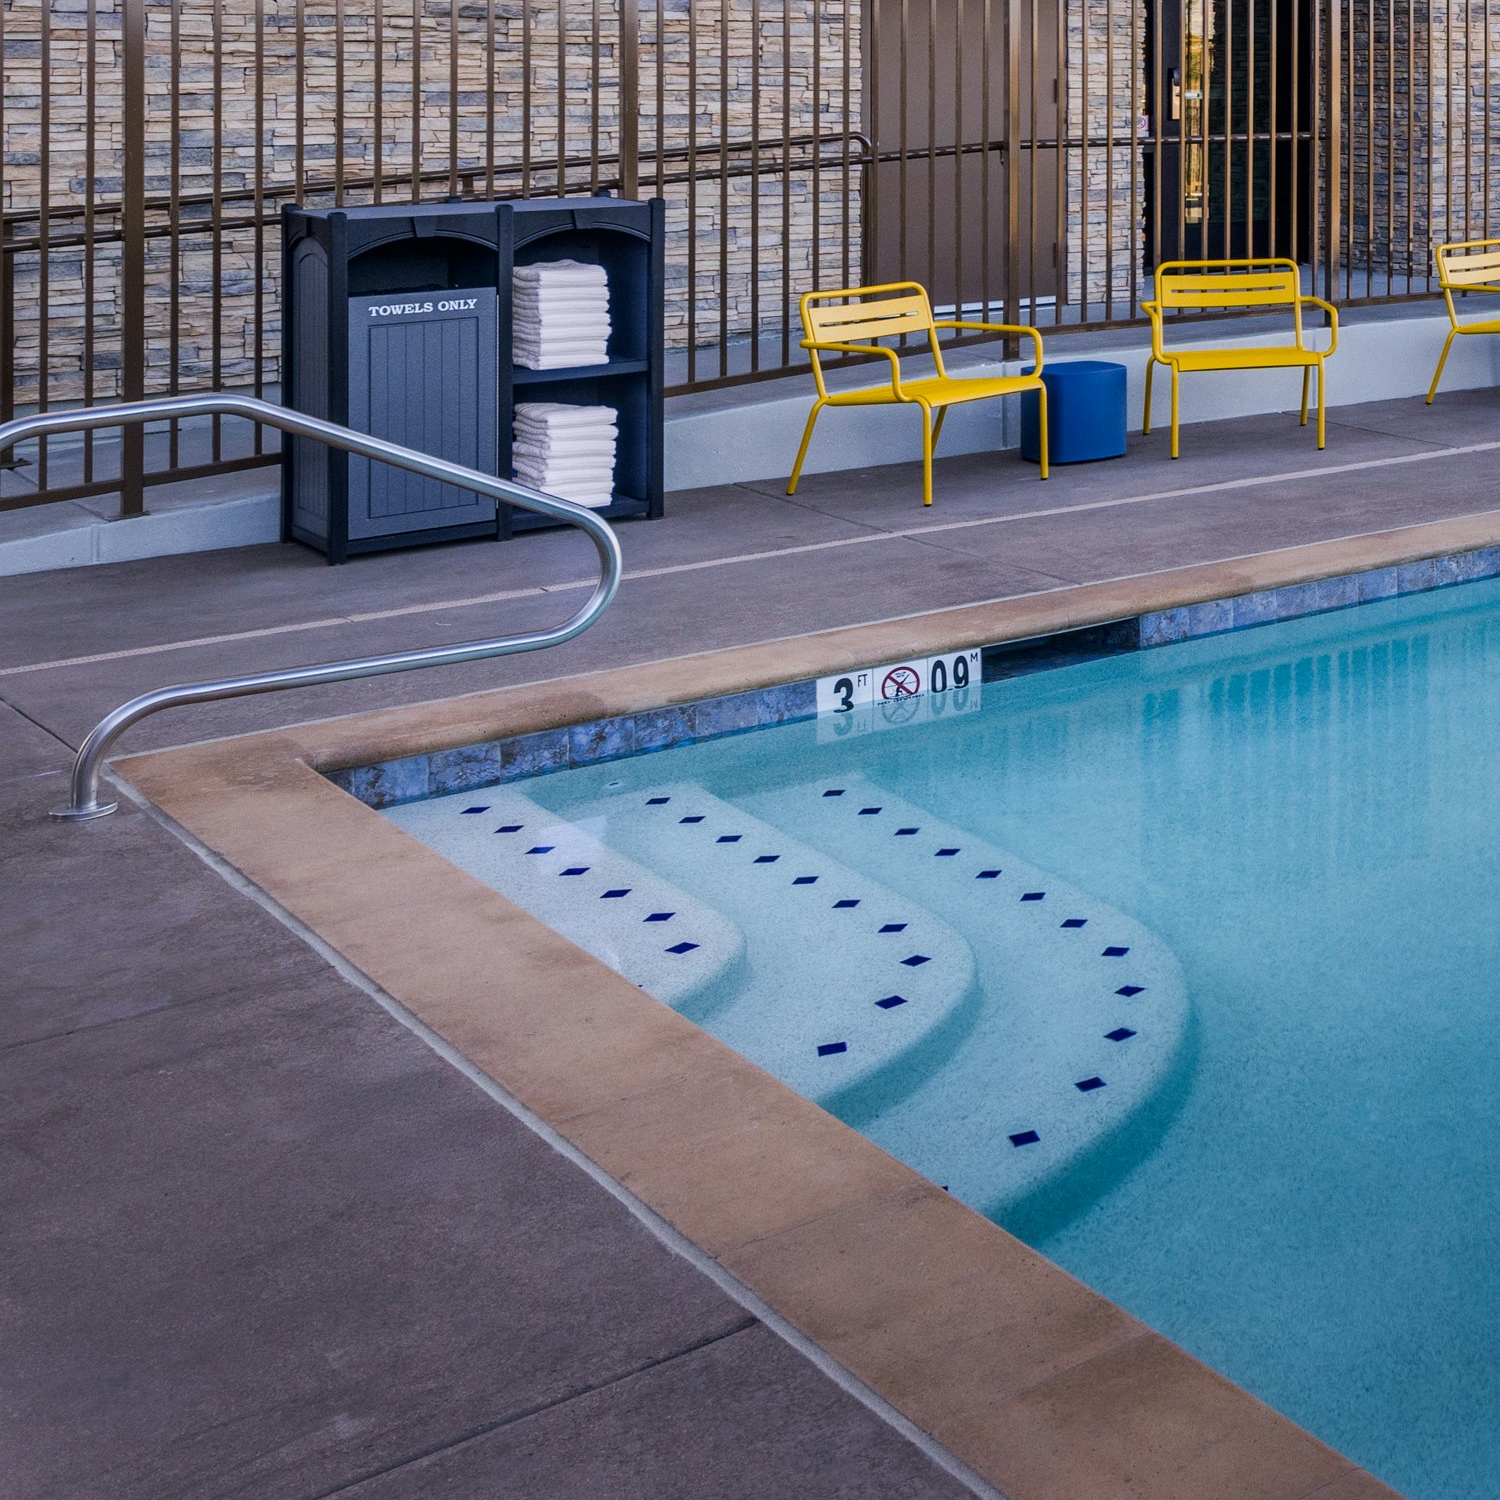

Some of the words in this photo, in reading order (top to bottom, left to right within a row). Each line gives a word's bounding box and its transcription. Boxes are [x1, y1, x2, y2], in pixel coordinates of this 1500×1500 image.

[368, 302, 434, 317] TOWELS
[437, 298, 478, 312] ONLY
[970, 651, 979, 663] M
[833, 677, 854, 714] 3
[857, 673, 868, 688] FT
